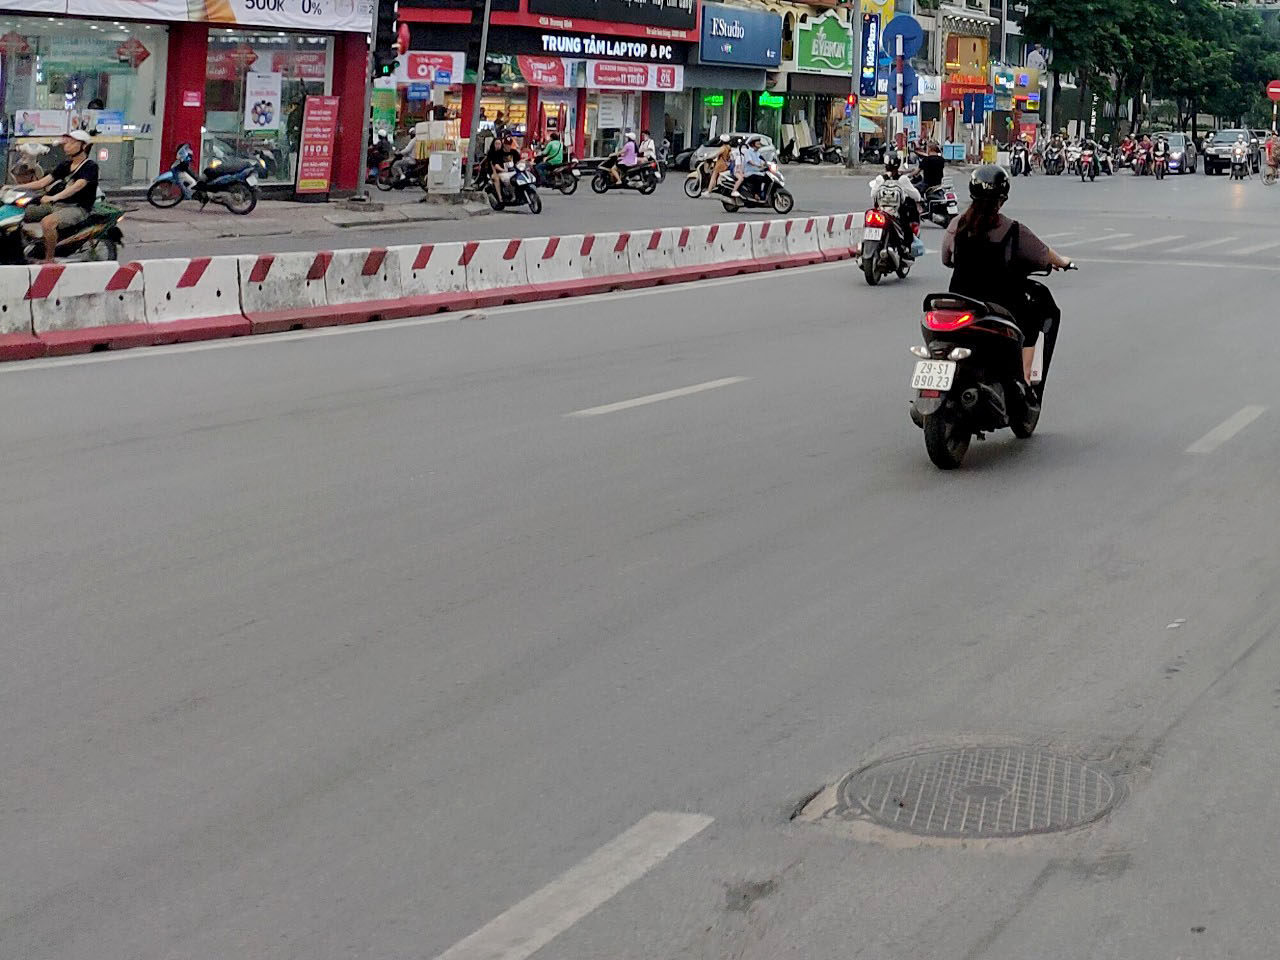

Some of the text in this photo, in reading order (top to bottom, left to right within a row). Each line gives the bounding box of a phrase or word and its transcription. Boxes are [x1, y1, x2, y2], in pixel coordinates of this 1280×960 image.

[541, 35, 581, 54] TRUNG
[582, 34, 606, 54] TÂM
[606, 40, 648, 57] LAPTOP
[658, 45, 672, 59] PC
[920, 362, 949, 375] 29-S1
[914, 375, 950, 388] 890.23
